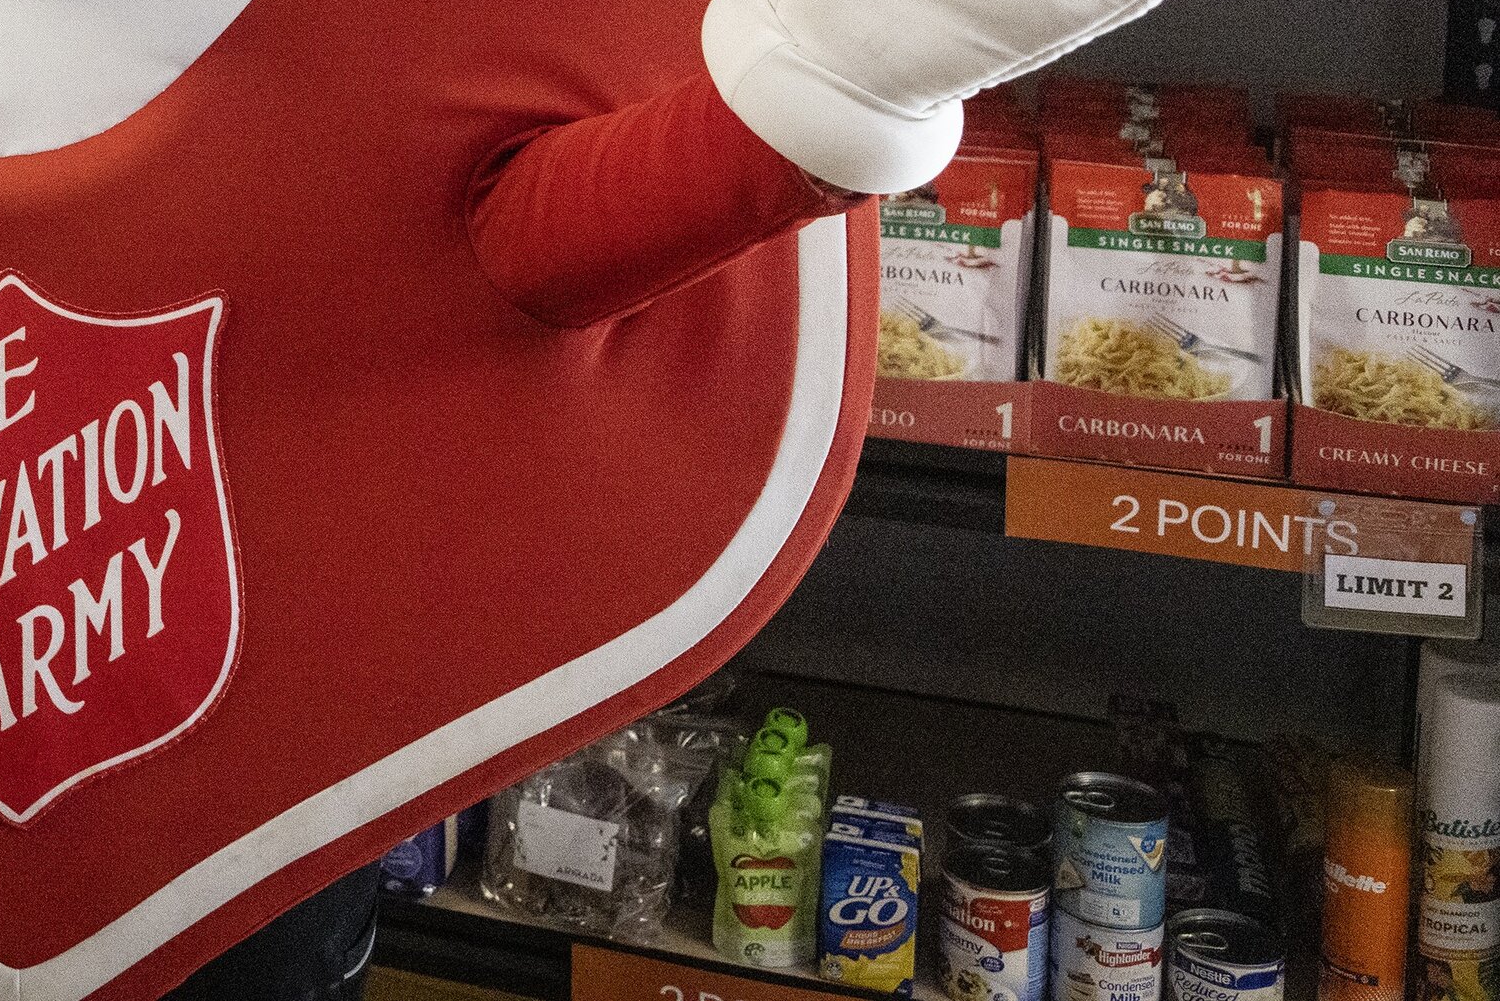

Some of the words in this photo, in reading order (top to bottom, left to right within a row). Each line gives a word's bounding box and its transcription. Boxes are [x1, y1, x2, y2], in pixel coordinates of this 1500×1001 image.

[914, 226, 971, 243] SNACK
[1222, 221, 1241, 230] FOR
[1242, 222, 1262, 231] ONE
[1099, 236, 1165, 251] SINGLE
[1172, 240, 1235, 257] SNACK
[1398, 246, 1423, 258] SAN
[1424, 247, 1460, 260] REMO
[880, 265, 964, 286] BONARA
[1353, 263, 1426, 280] SINGLE
[1434, 269, 1500, 286] SNACK
[1100, 276, 1230, 303] CARBONARA
[1355, 307, 1496, 334] CARBONARA
[995, 401, 1013, 440] 1
[1058, 414, 1206, 445] CARBONARA
[963, 438, 986, 447] FOR
[987, 440, 1011, 450] ONE
[1253, 415, 1273, 454] 1
[1218, 452, 1242, 463] FOR
[1244, 454, 1270, 465] ONE
[1318, 446, 1403, 468] CREAMY
[1411, 456, 1491, 477] CHEESE
[1109, 494, 1141, 534] 2
[1156, 499, 1360, 556] POINTS
[1336, 573, 1428, 599] LIMIT
[1437, 582, 1455, 601] 2
[734, 875, 794, 891] APPLE
[1091, 869, 1122, 885] Milk
[828, 896, 909, 926] GO
[1421, 917, 1488, 935] TROPICAL
[1098, 949, 1151, 967] Highlander
[1098, 977, 1156, 993] Condensed
[1174, 969, 1240, 1001] Reduced
[1189, 962, 1231, 986] Nestlé
